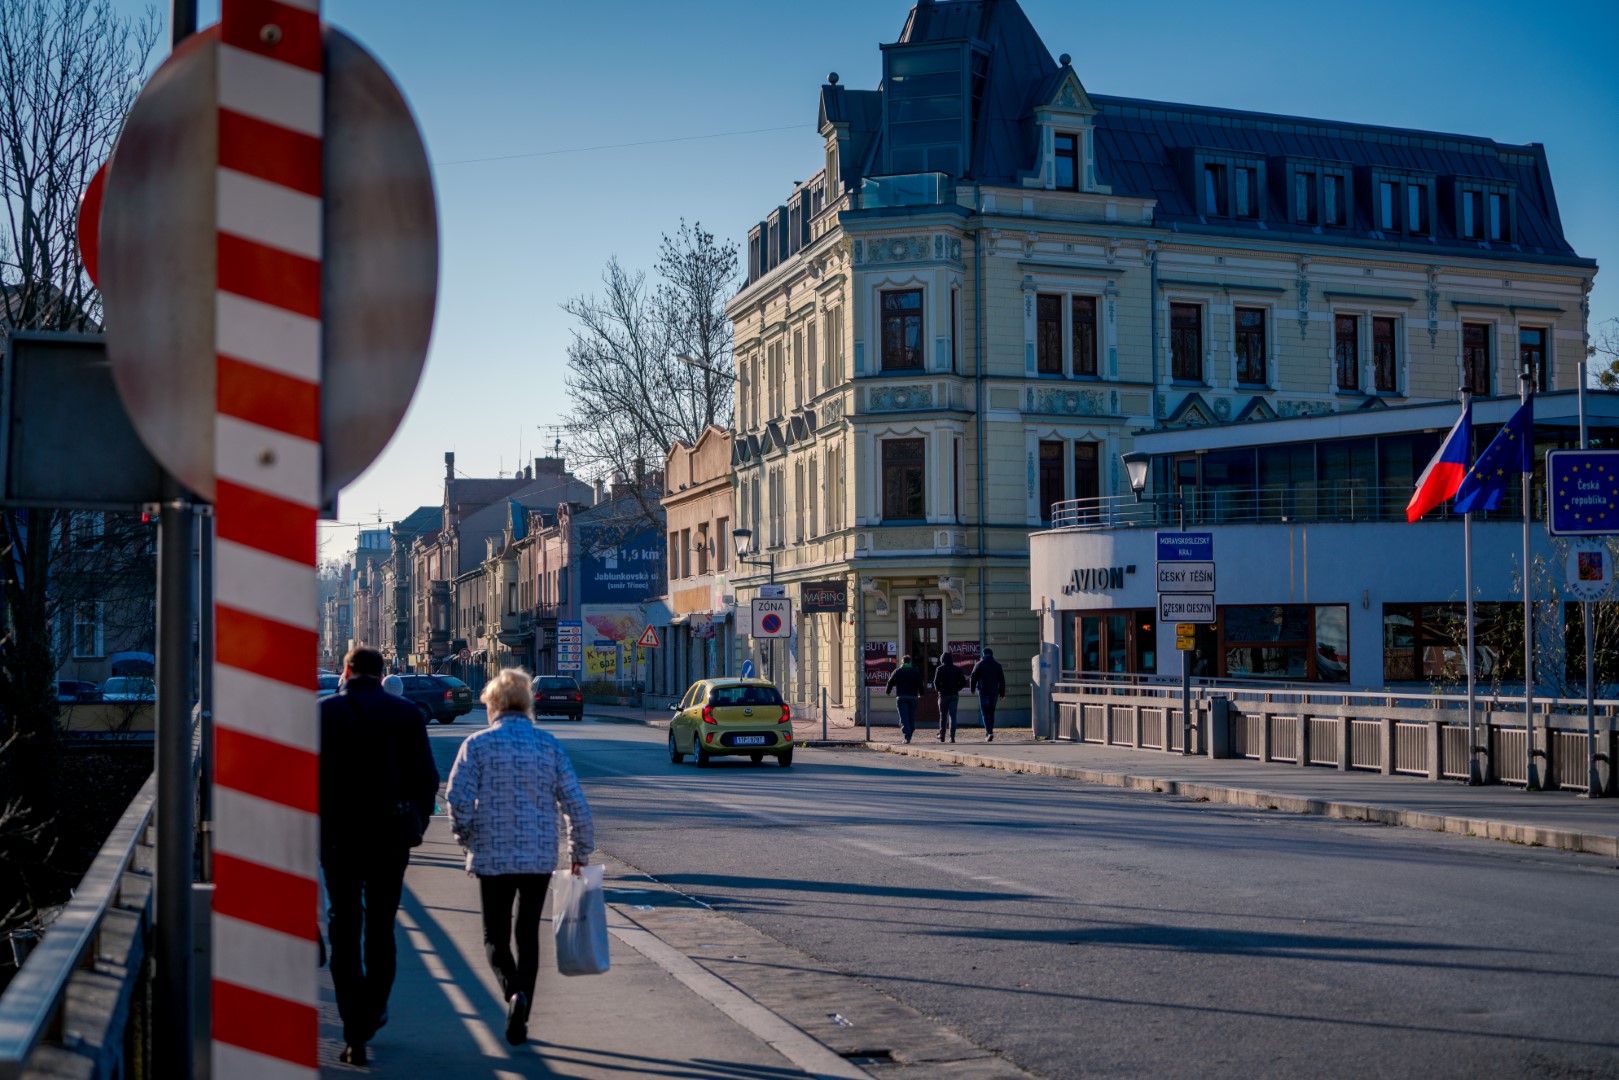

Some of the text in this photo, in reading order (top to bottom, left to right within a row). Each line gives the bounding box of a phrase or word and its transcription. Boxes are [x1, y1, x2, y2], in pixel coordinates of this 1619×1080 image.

[1577, 478, 1600, 490] Česká
[1571, 494, 1607, 507] republika
[1159, 536, 1210, 545] MORAVSKOSLEZSKÝ
[641, 548, 659, 560] km
[1178, 547, 1192, 556] KRAJ
[594, 571, 649, 581] Jablunkovská
[1159, 569, 1213, 582] ČESKÝ TĚŠÍN
[804, 592, 845, 602] MARINO
[758, 600, 784, 611] ZÓNA
[1186, 602, 1212, 613] CIESZYN
[865, 642, 887, 651] BUTY
[865, 672, 892, 680] MARIN
